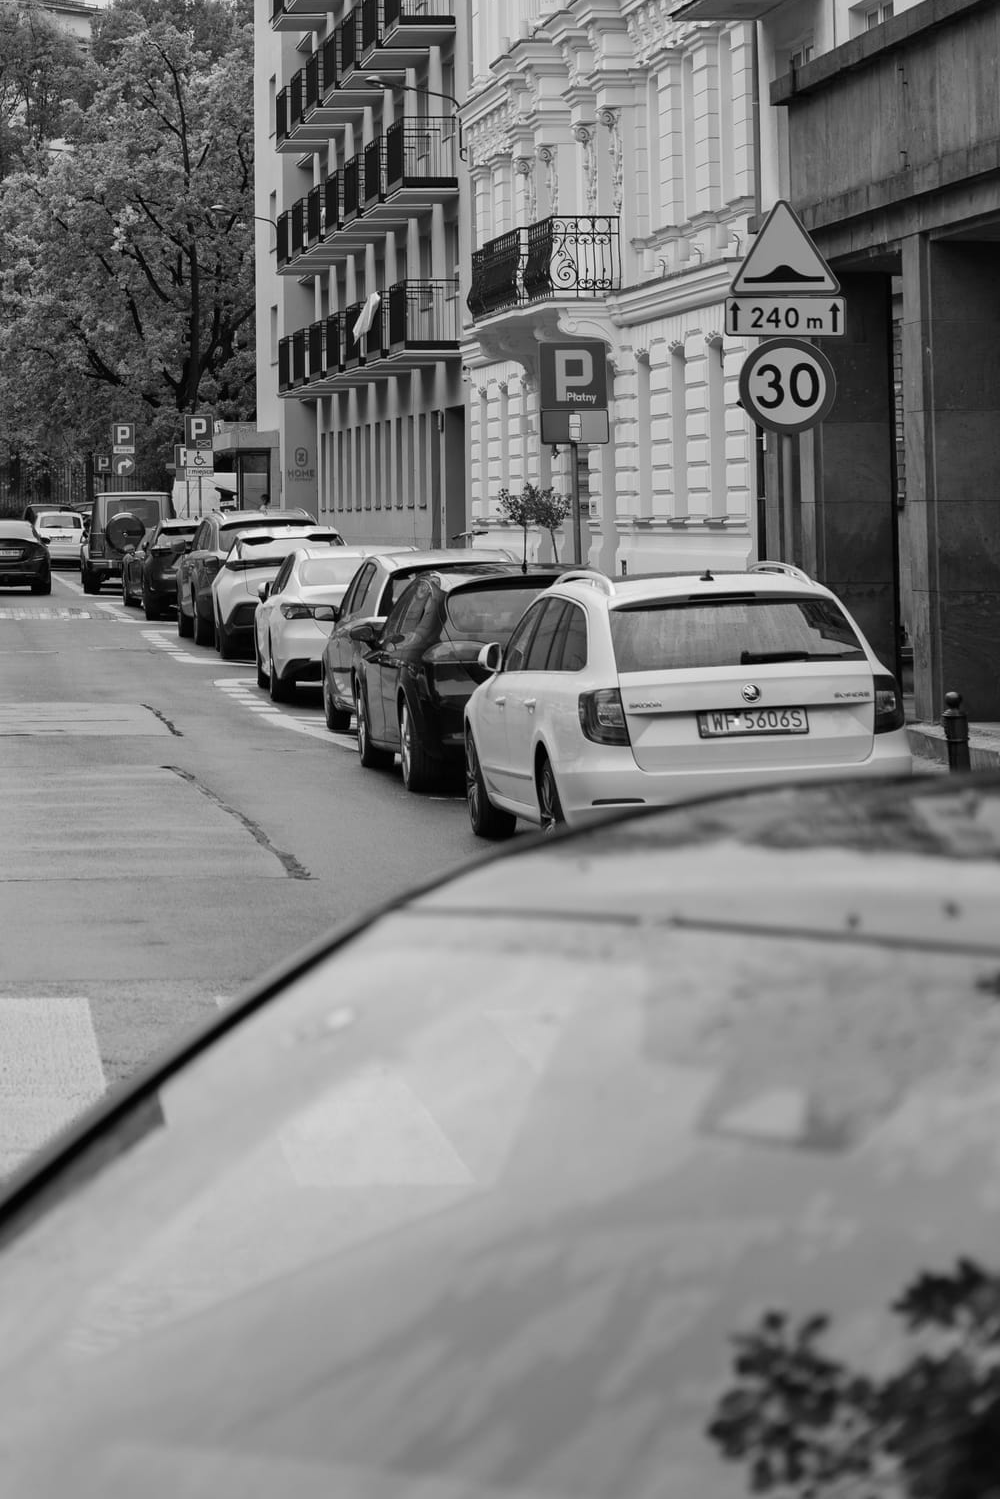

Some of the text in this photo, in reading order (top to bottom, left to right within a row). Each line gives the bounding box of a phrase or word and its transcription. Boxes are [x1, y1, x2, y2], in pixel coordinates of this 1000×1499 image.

[750, 306, 823, 329] 240 m
[554, 349, 594, 402] P
[756, 362, 820, 409] 30
[567, 392, 597, 405] Płatny
[117, 426, 130, 444] P
[191, 418, 207, 440] P
[98, 456, 109, 471] P
[287, 469, 315, 478] HOME
[711, 710, 803, 731] WF 5606S
